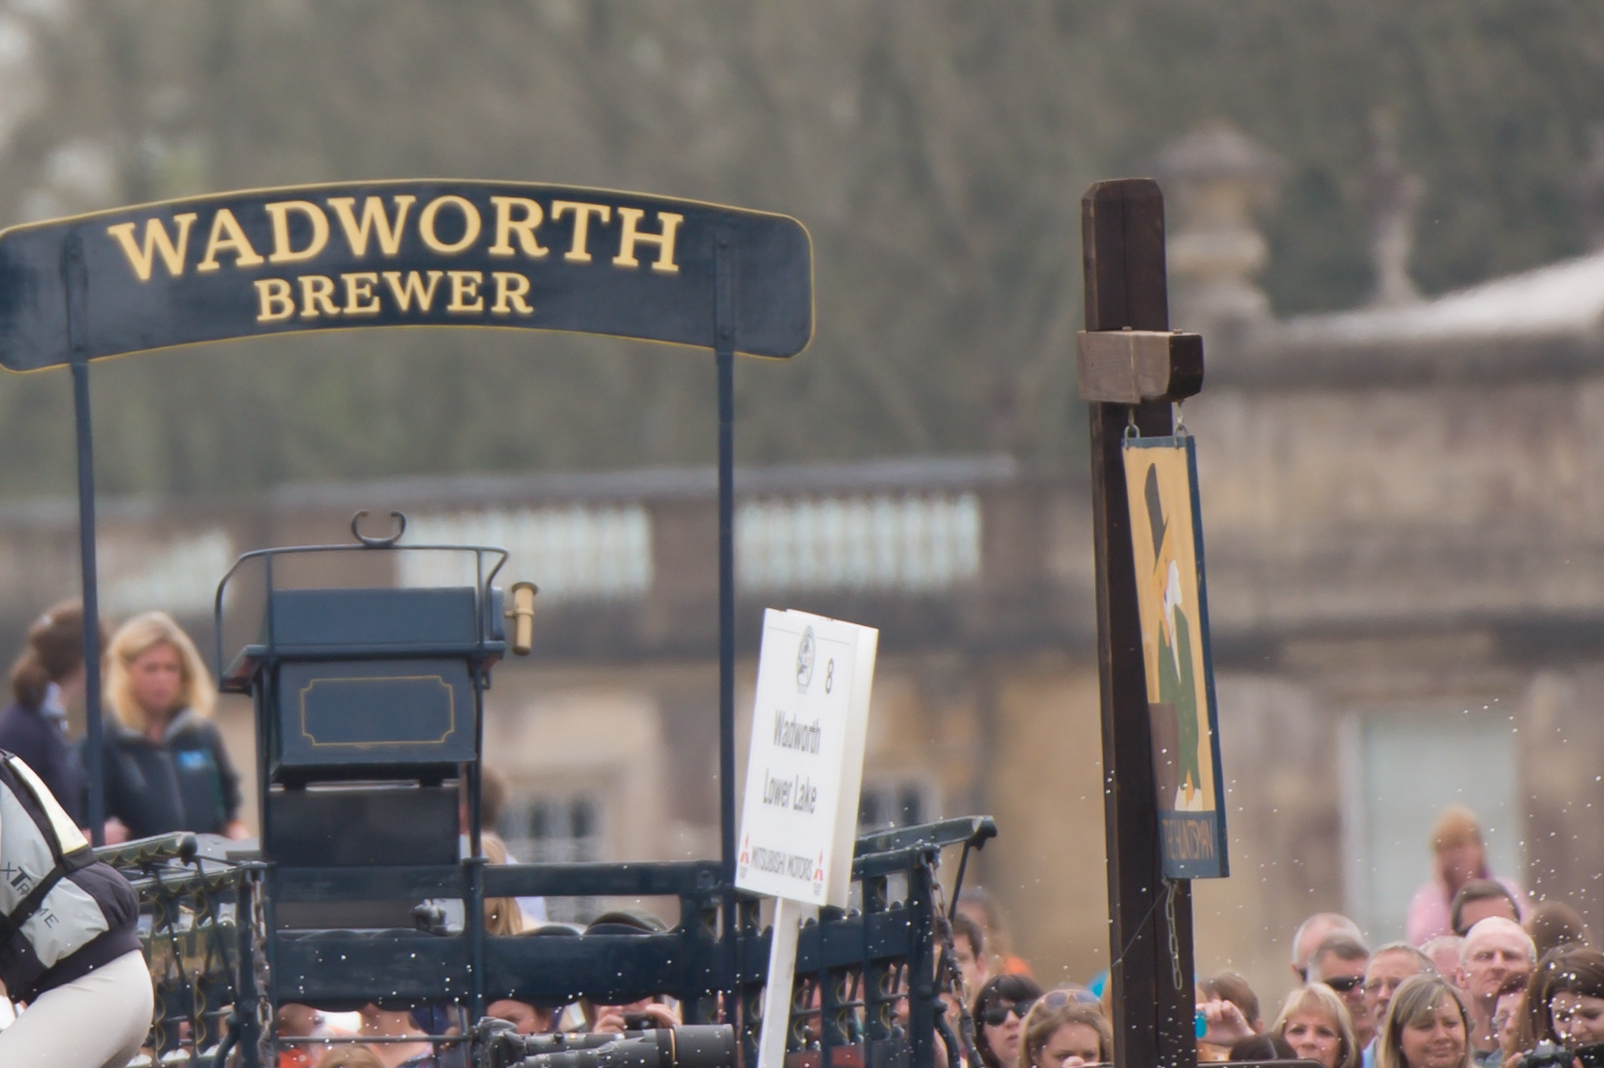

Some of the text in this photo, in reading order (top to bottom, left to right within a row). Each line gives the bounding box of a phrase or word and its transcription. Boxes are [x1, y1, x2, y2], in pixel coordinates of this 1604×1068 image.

[107, 195, 684, 280] WADWORTH
[253, 271, 534, 321] BREWER
[825, 658, 834, 694] 8
[774, 710, 821, 755] Wadworth
[763, 767, 817, 814] Lower Lake
